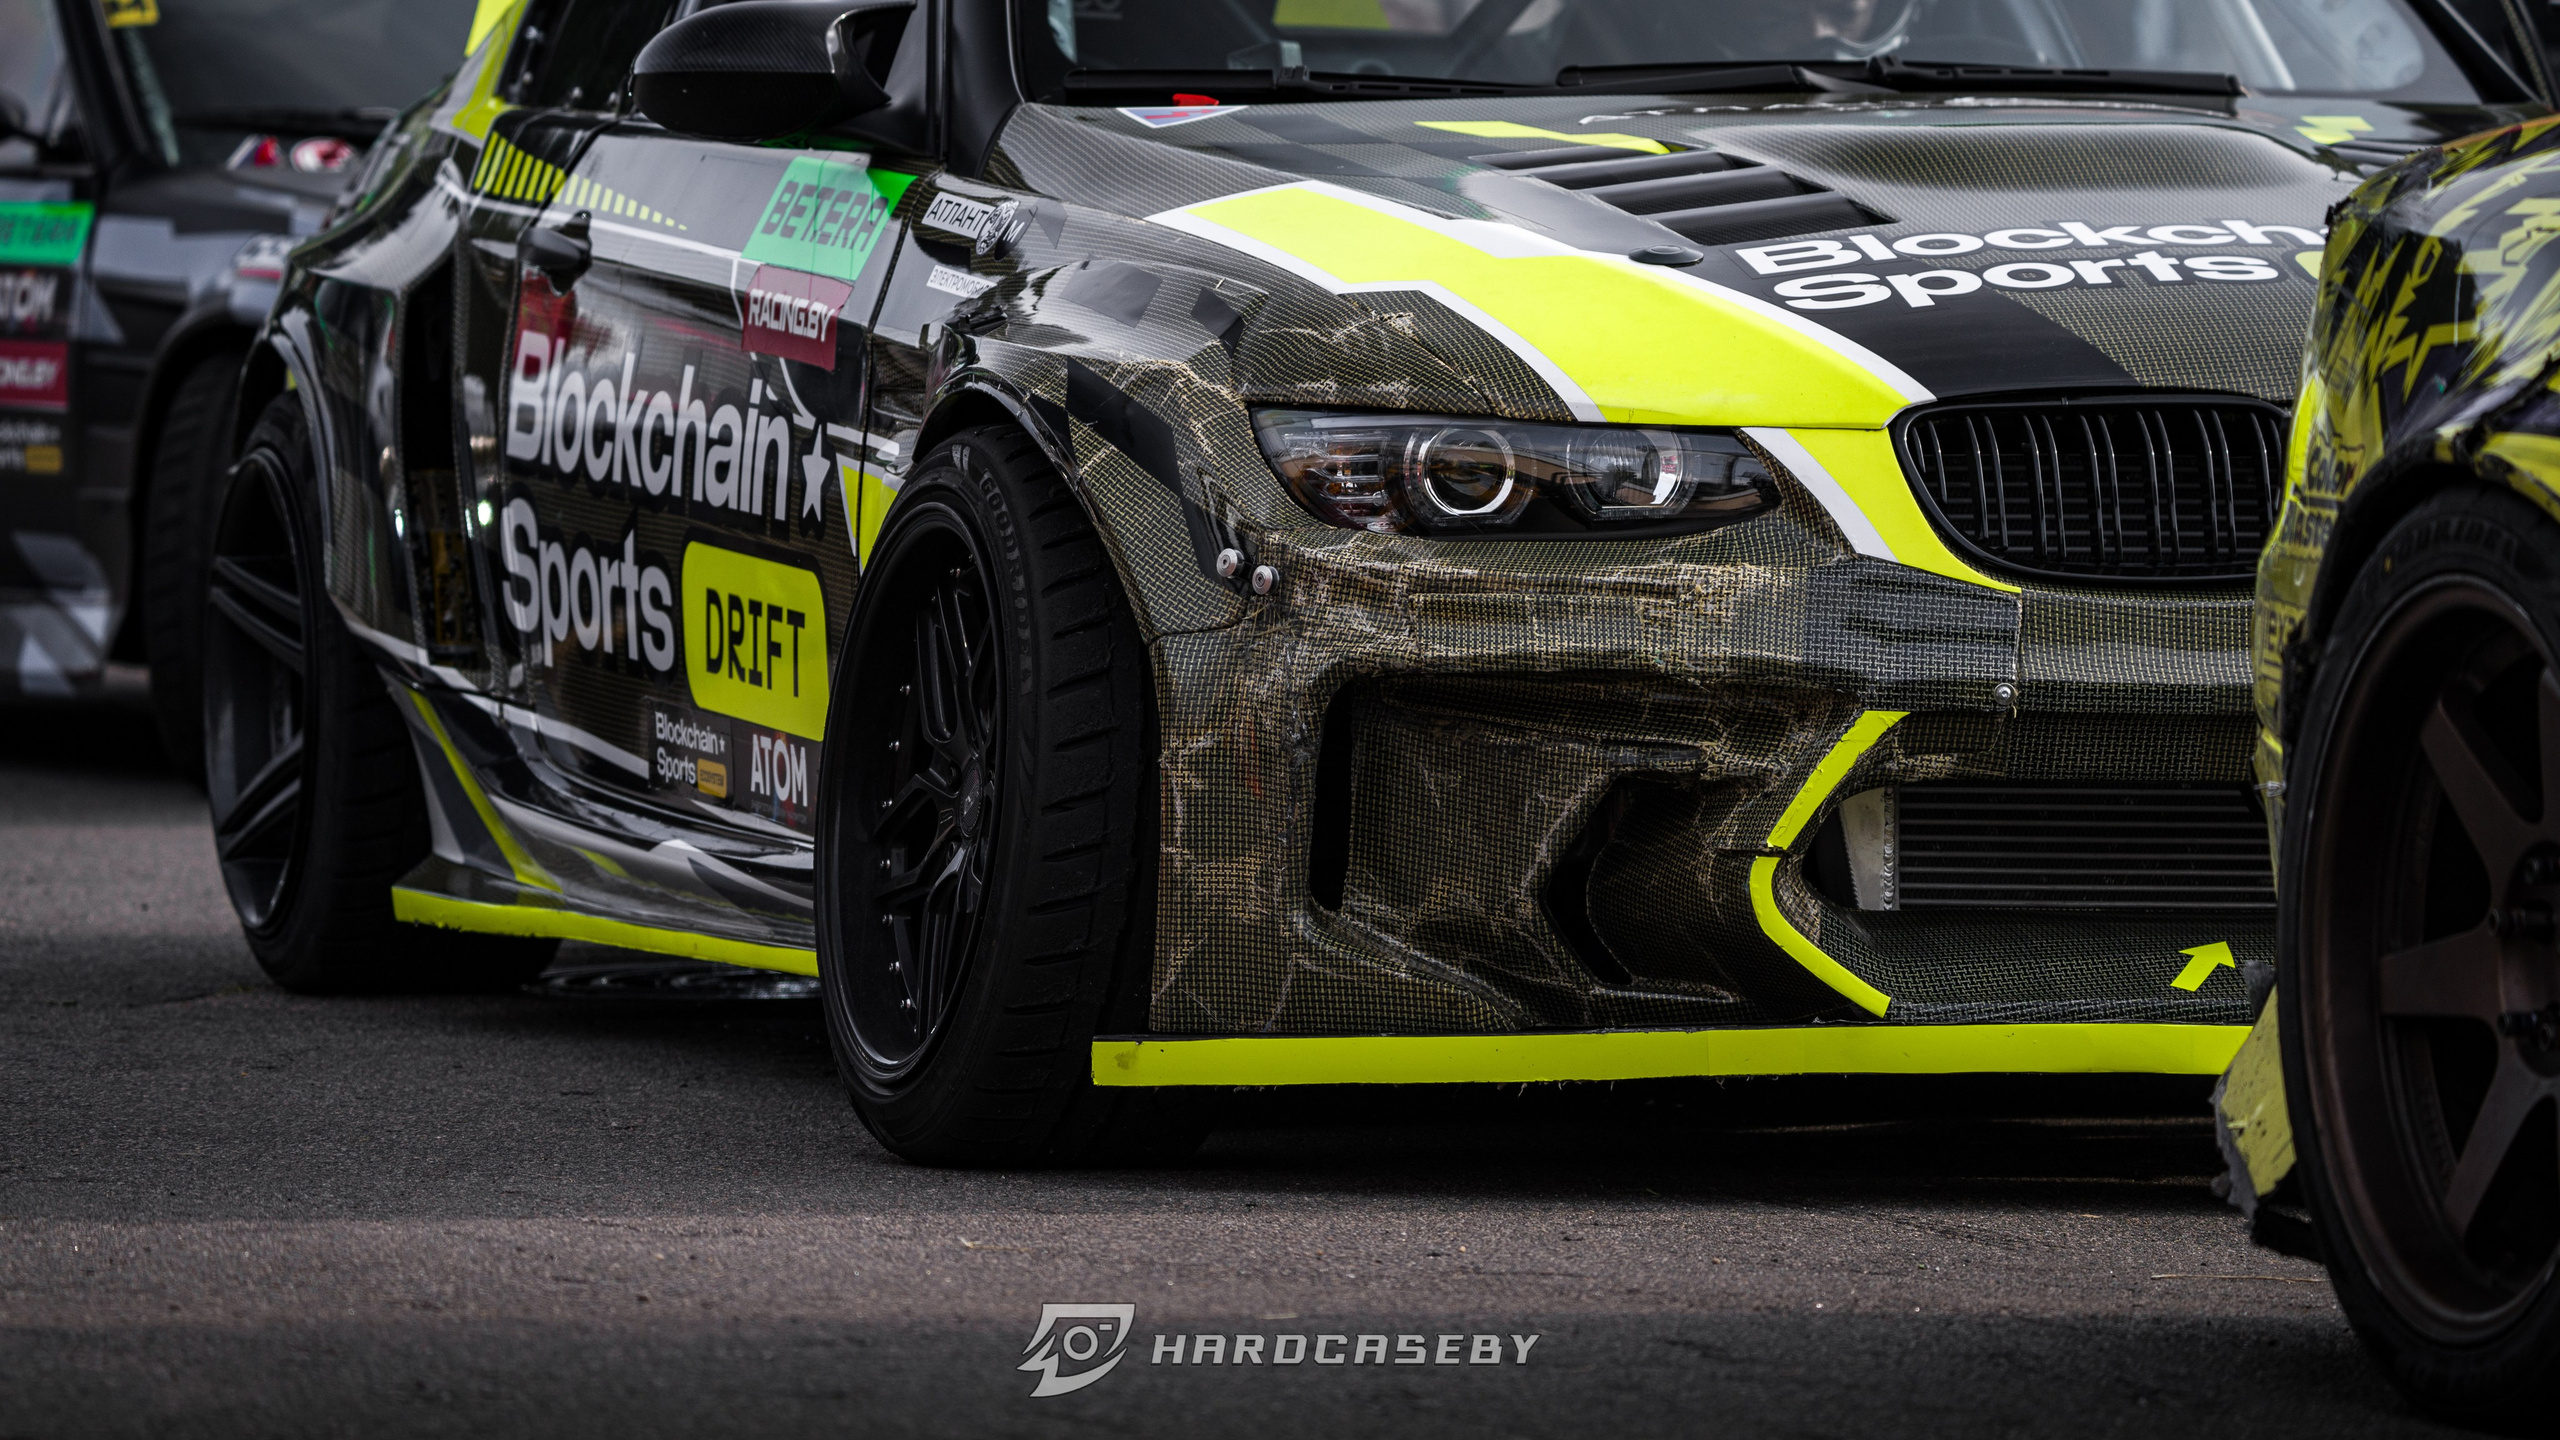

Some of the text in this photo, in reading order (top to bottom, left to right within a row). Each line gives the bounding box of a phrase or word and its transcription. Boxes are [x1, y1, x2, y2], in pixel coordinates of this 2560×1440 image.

[761, 180, 889, 252] BETERA
[926, 198, 989, 232] АТЛАНТ
[1734, 218, 2328, 276] Blockch
[1773, 250, 2280, 310] Sports
[748, 288, 835, 342] RACING.BY
[506, 330, 792, 522] Blockchain
[502, 497, 675, 672] Sports
[706, 586, 805, 698] DRIFT
[655, 711, 718, 755] Blockchain
[657, 746, 697, 785] Sports
[751, 733, 808, 807] ATOM
